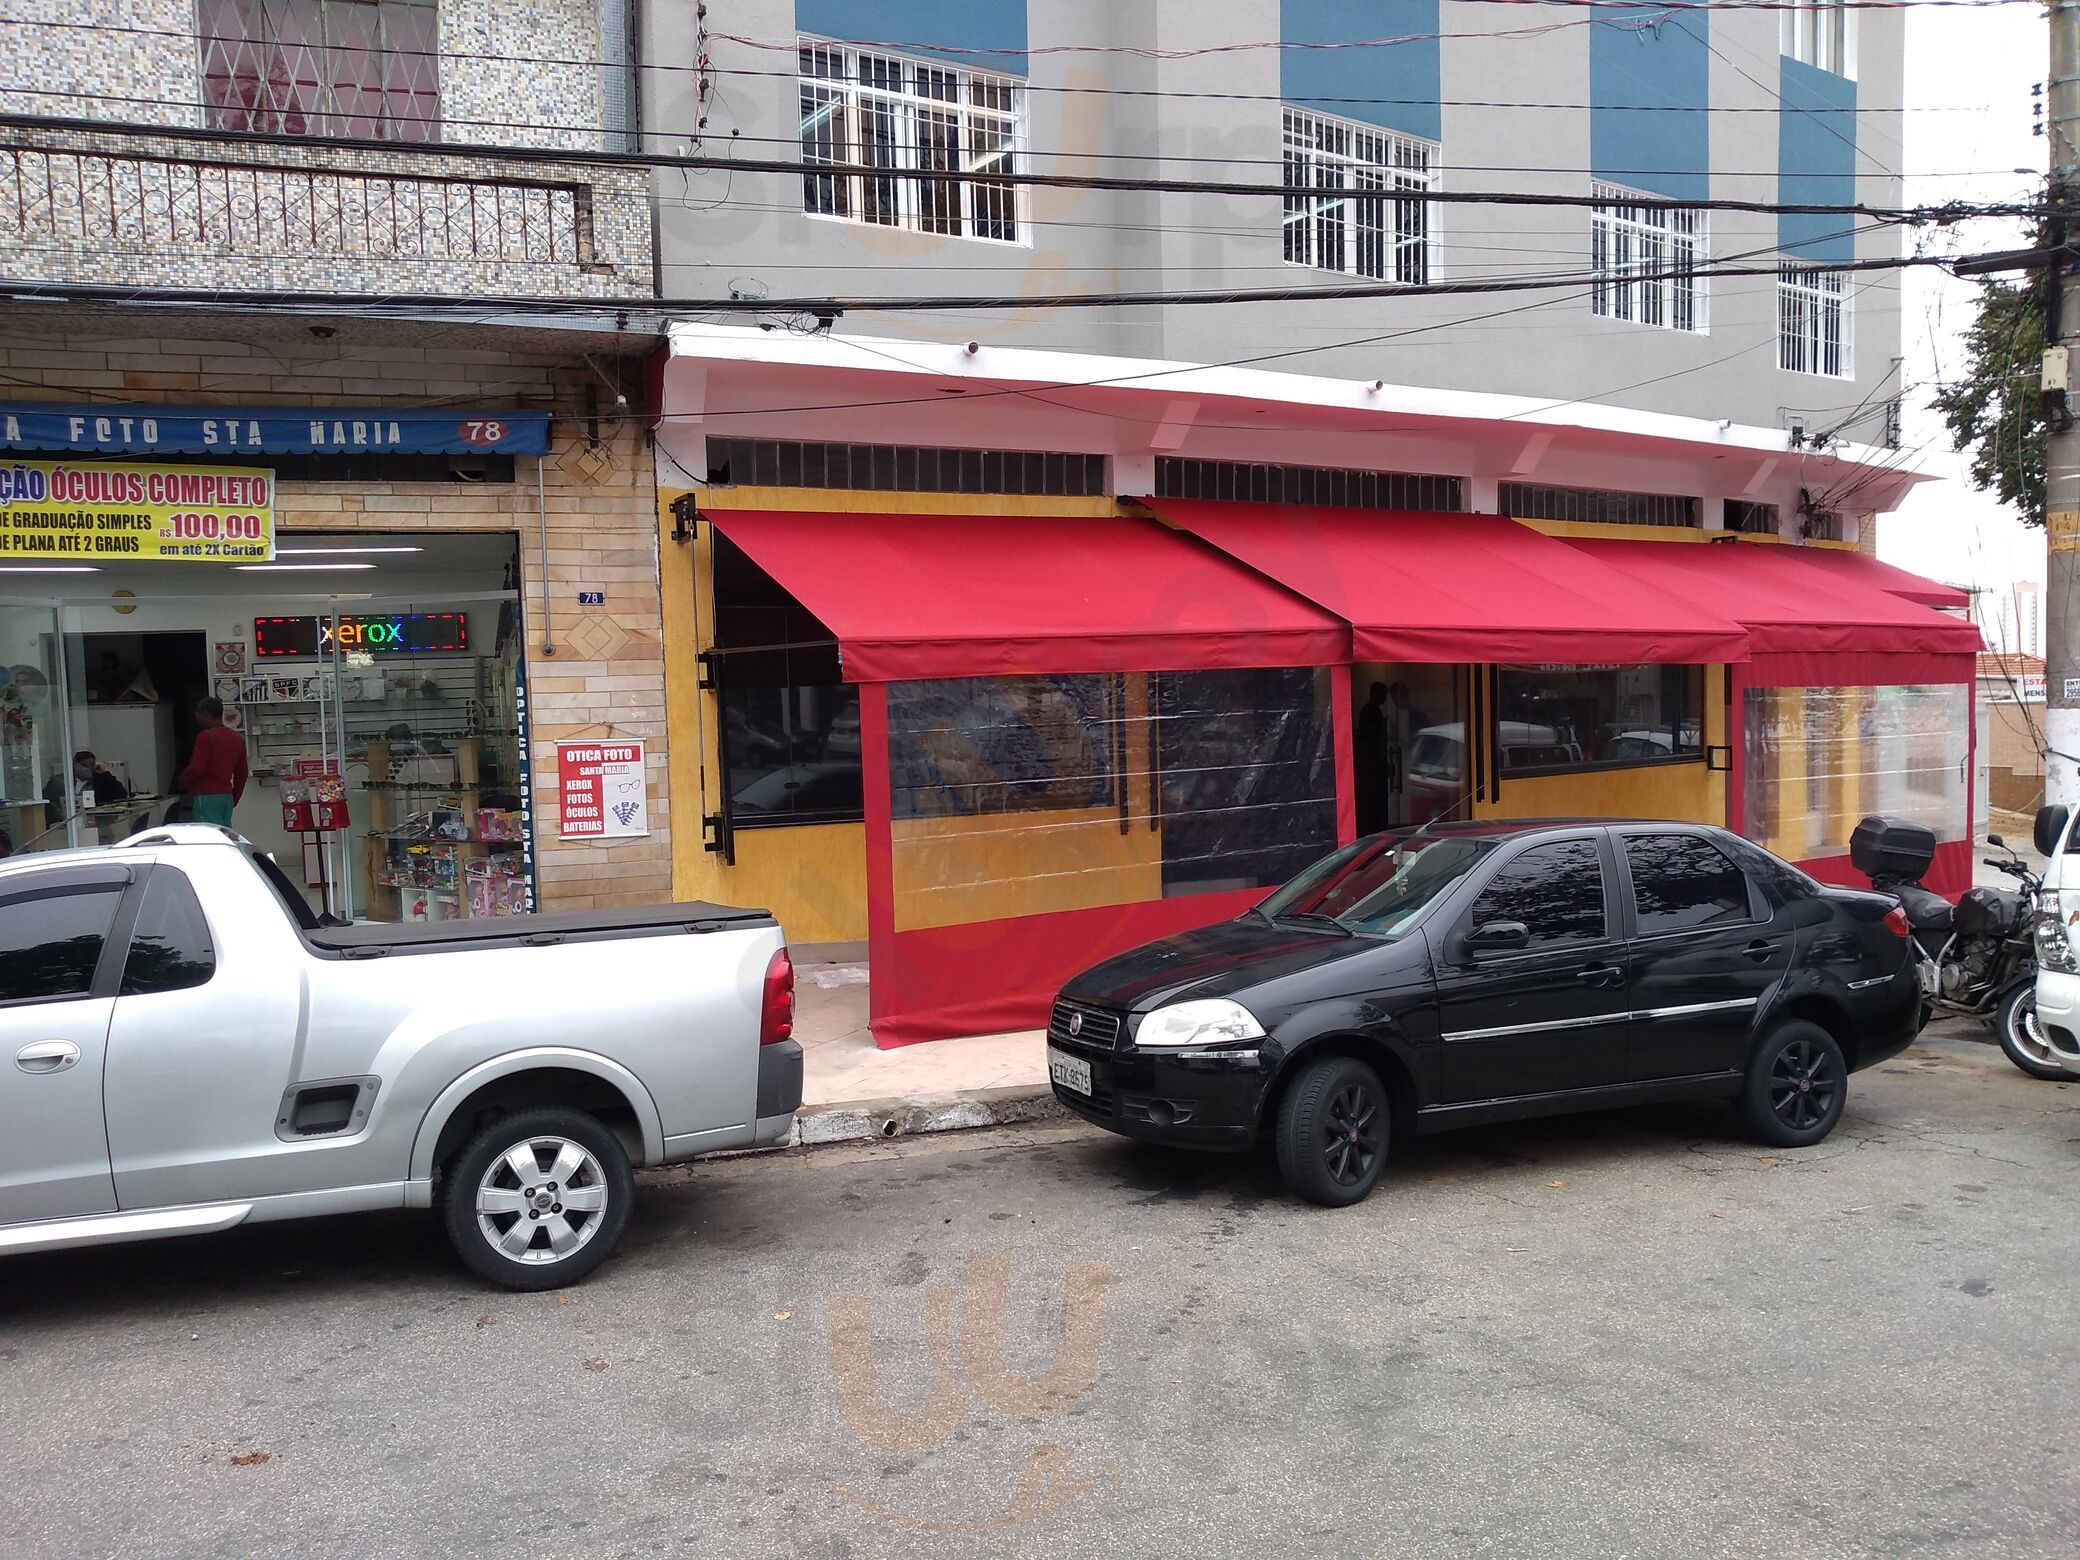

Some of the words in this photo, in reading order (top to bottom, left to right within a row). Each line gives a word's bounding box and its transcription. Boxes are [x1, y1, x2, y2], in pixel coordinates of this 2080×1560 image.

[69, 417, 159, 443] FOTO
[202, 420, 262, 446] STA
[310, 421, 401, 445] MARIA
[467, 422, 501, 441] 78
[51, 466, 143, 503] ÓCULOS
[149, 474, 267, 507] COMPLETO
[0, 511, 9, 528] E
[13, 510, 94, 531] GRADUAÇÃO
[97, 514, 152, 531] SIMPLES
[169, 513, 261, 541] 100,00
[0, 534, 9, 550] E
[13, 534, 54, 551] PLANA
[58, 534, 82, 552] ATÉ
[83, 536, 92, 552] 2
[95, 536, 140, 553] GRAUS
[160, 546, 180, 555] em
[182, 543, 202, 556] até
[205, 544, 220, 556] 2X
[222, 544, 264, 556] Cartão
[585, 594, 598, 604] 78
[320, 623, 404, 644] xerox
[274, 680, 298, 688] SPFC
[566, 749, 602, 762] OTICA
[604, 748, 633, 761] FOTO
[579, 766, 603, 775] SANTA
[604, 765, 630, 774] MARIA
[566, 780, 593, 790] XEROX
[519, 773, 530, 821] FOTO
[567, 793, 593, 804] FOTOS
[566, 806, 599, 818] ÓCULOS
[563, 820, 603, 833] BATERIAS
[522, 829, 532, 863] STA
